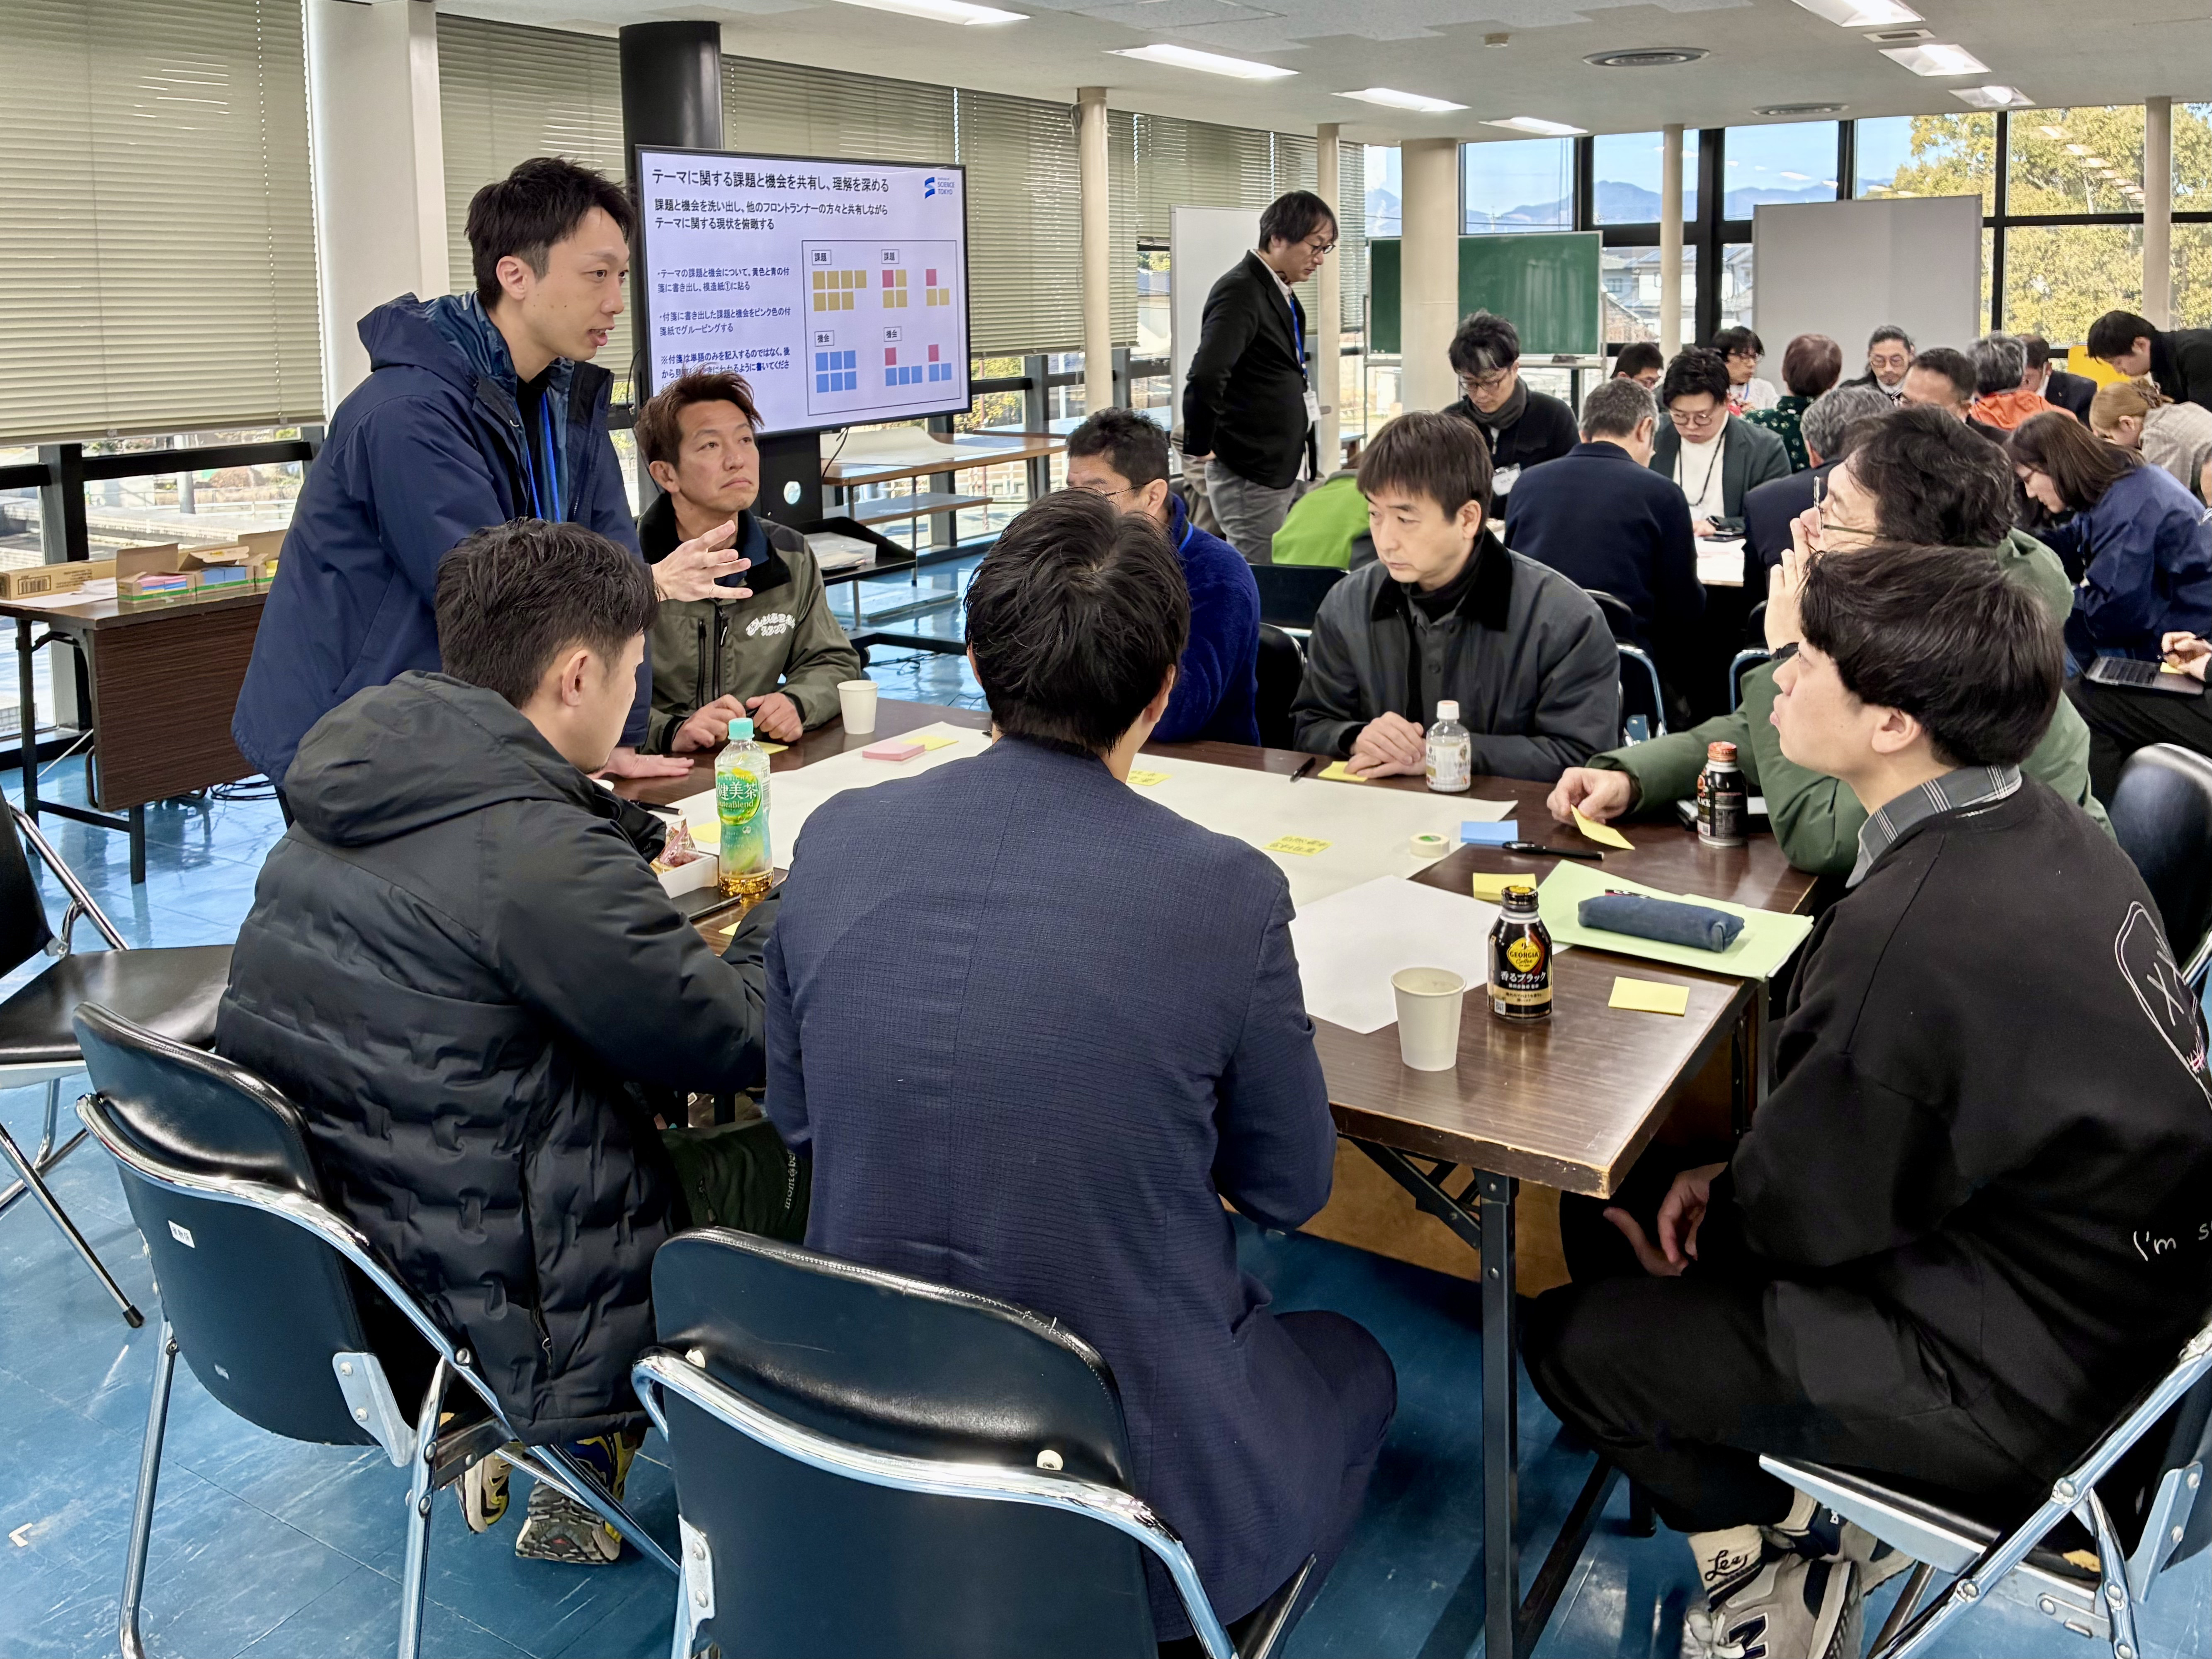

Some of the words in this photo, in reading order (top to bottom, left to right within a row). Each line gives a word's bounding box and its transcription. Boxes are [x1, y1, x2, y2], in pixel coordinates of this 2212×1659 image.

[652, 169, 889, 192] テーマに関する課題と機会を共有し、理解を深める
[654, 198, 888, 215] 課題と機会を洗い出し、他のフロントランナーの方々と共有しながら
[655, 217, 775, 230] テーマに関する現状を俯瞰する
[814, 253, 827, 262] 課題
[884, 252, 895, 261] 課題
[657, 281, 750, 293] 箋に書き出し、模造紙①に貼る
[659, 323, 733, 336] 箋紙でグルーピングする
[886, 330, 897, 339] 機会
[817, 333, 830, 343] 機会
[717, 781, 758, 801] 健美茶
[1501, 971, 1546, 983] 香るブラック
